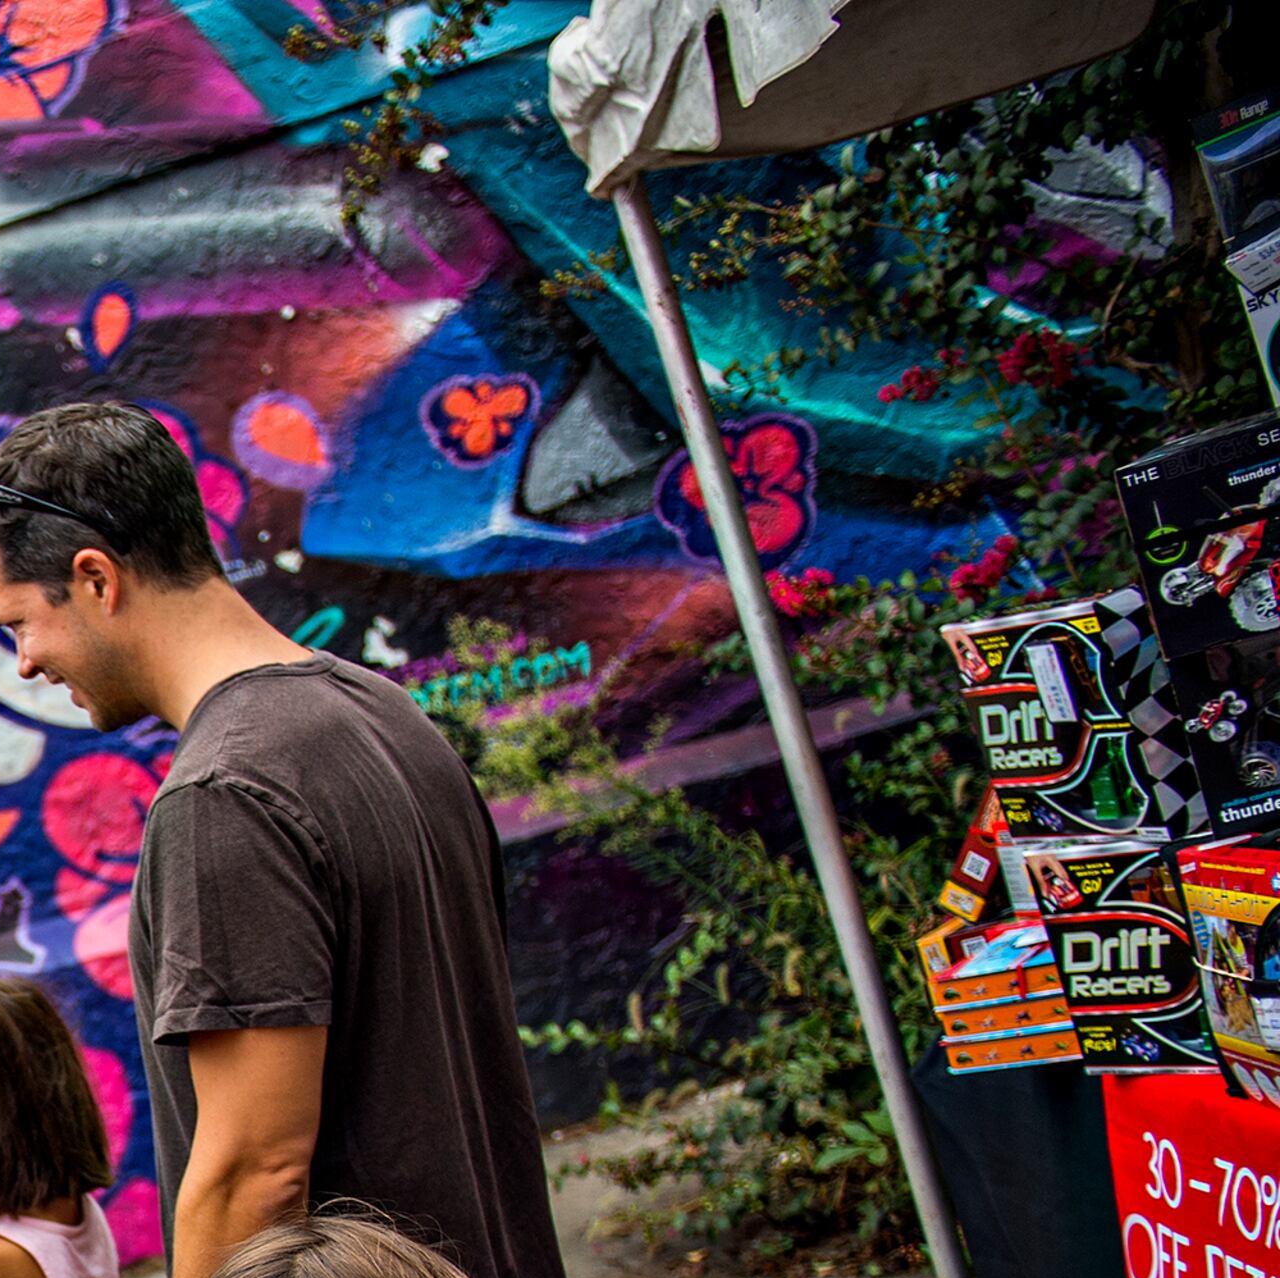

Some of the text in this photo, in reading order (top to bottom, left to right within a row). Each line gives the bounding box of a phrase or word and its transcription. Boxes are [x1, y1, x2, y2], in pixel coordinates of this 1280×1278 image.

[1123, 467, 1160, 487] THE
[1228, 465, 1277, 486] thunder
[988, 745, 1063, 770] Racers
[1061, 926, 1171, 974] Drift
[1070, 973, 1171, 998] Racers
